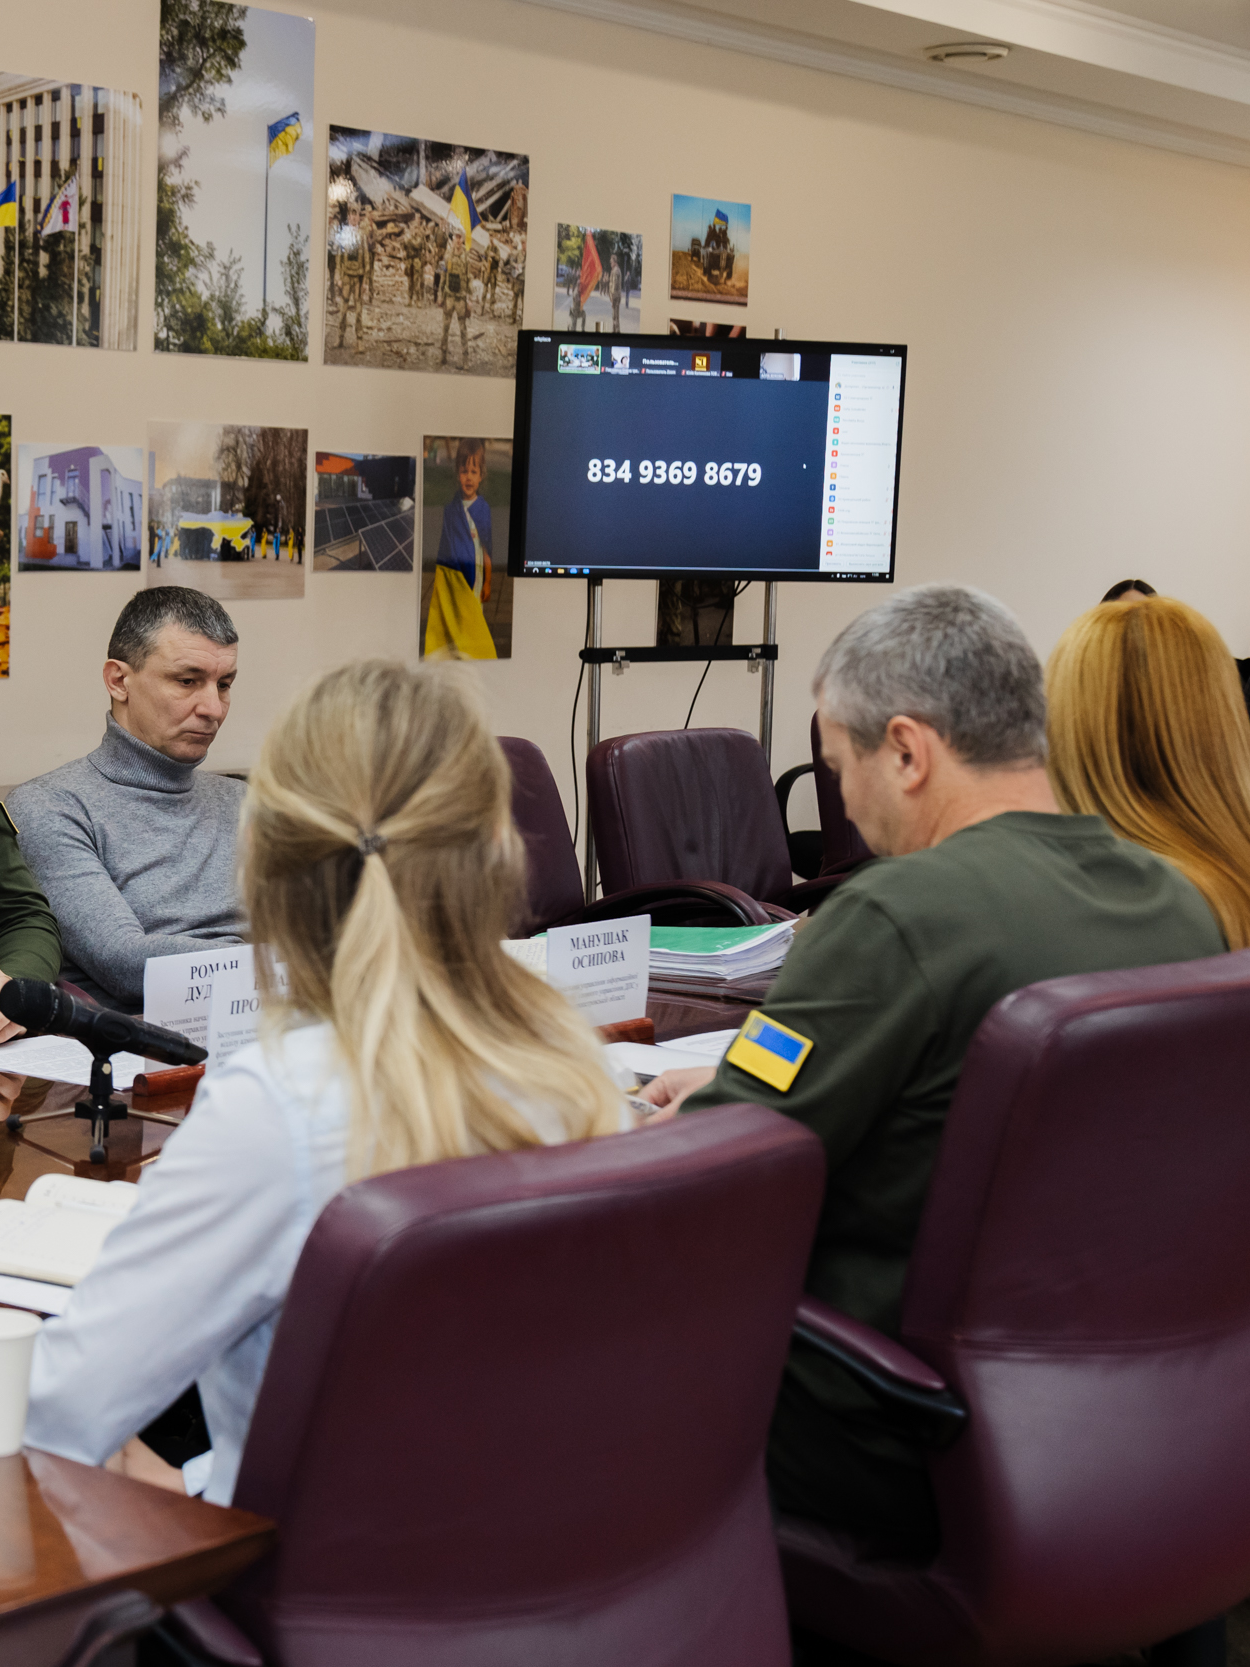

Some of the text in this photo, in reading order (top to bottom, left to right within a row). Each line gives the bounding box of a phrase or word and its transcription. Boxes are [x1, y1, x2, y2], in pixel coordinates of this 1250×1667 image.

[587, 458, 762, 487] 834 9369 8679
[570, 929, 629, 952] МАНУШАК
[572, 949, 625, 970] ОСИПОВА
